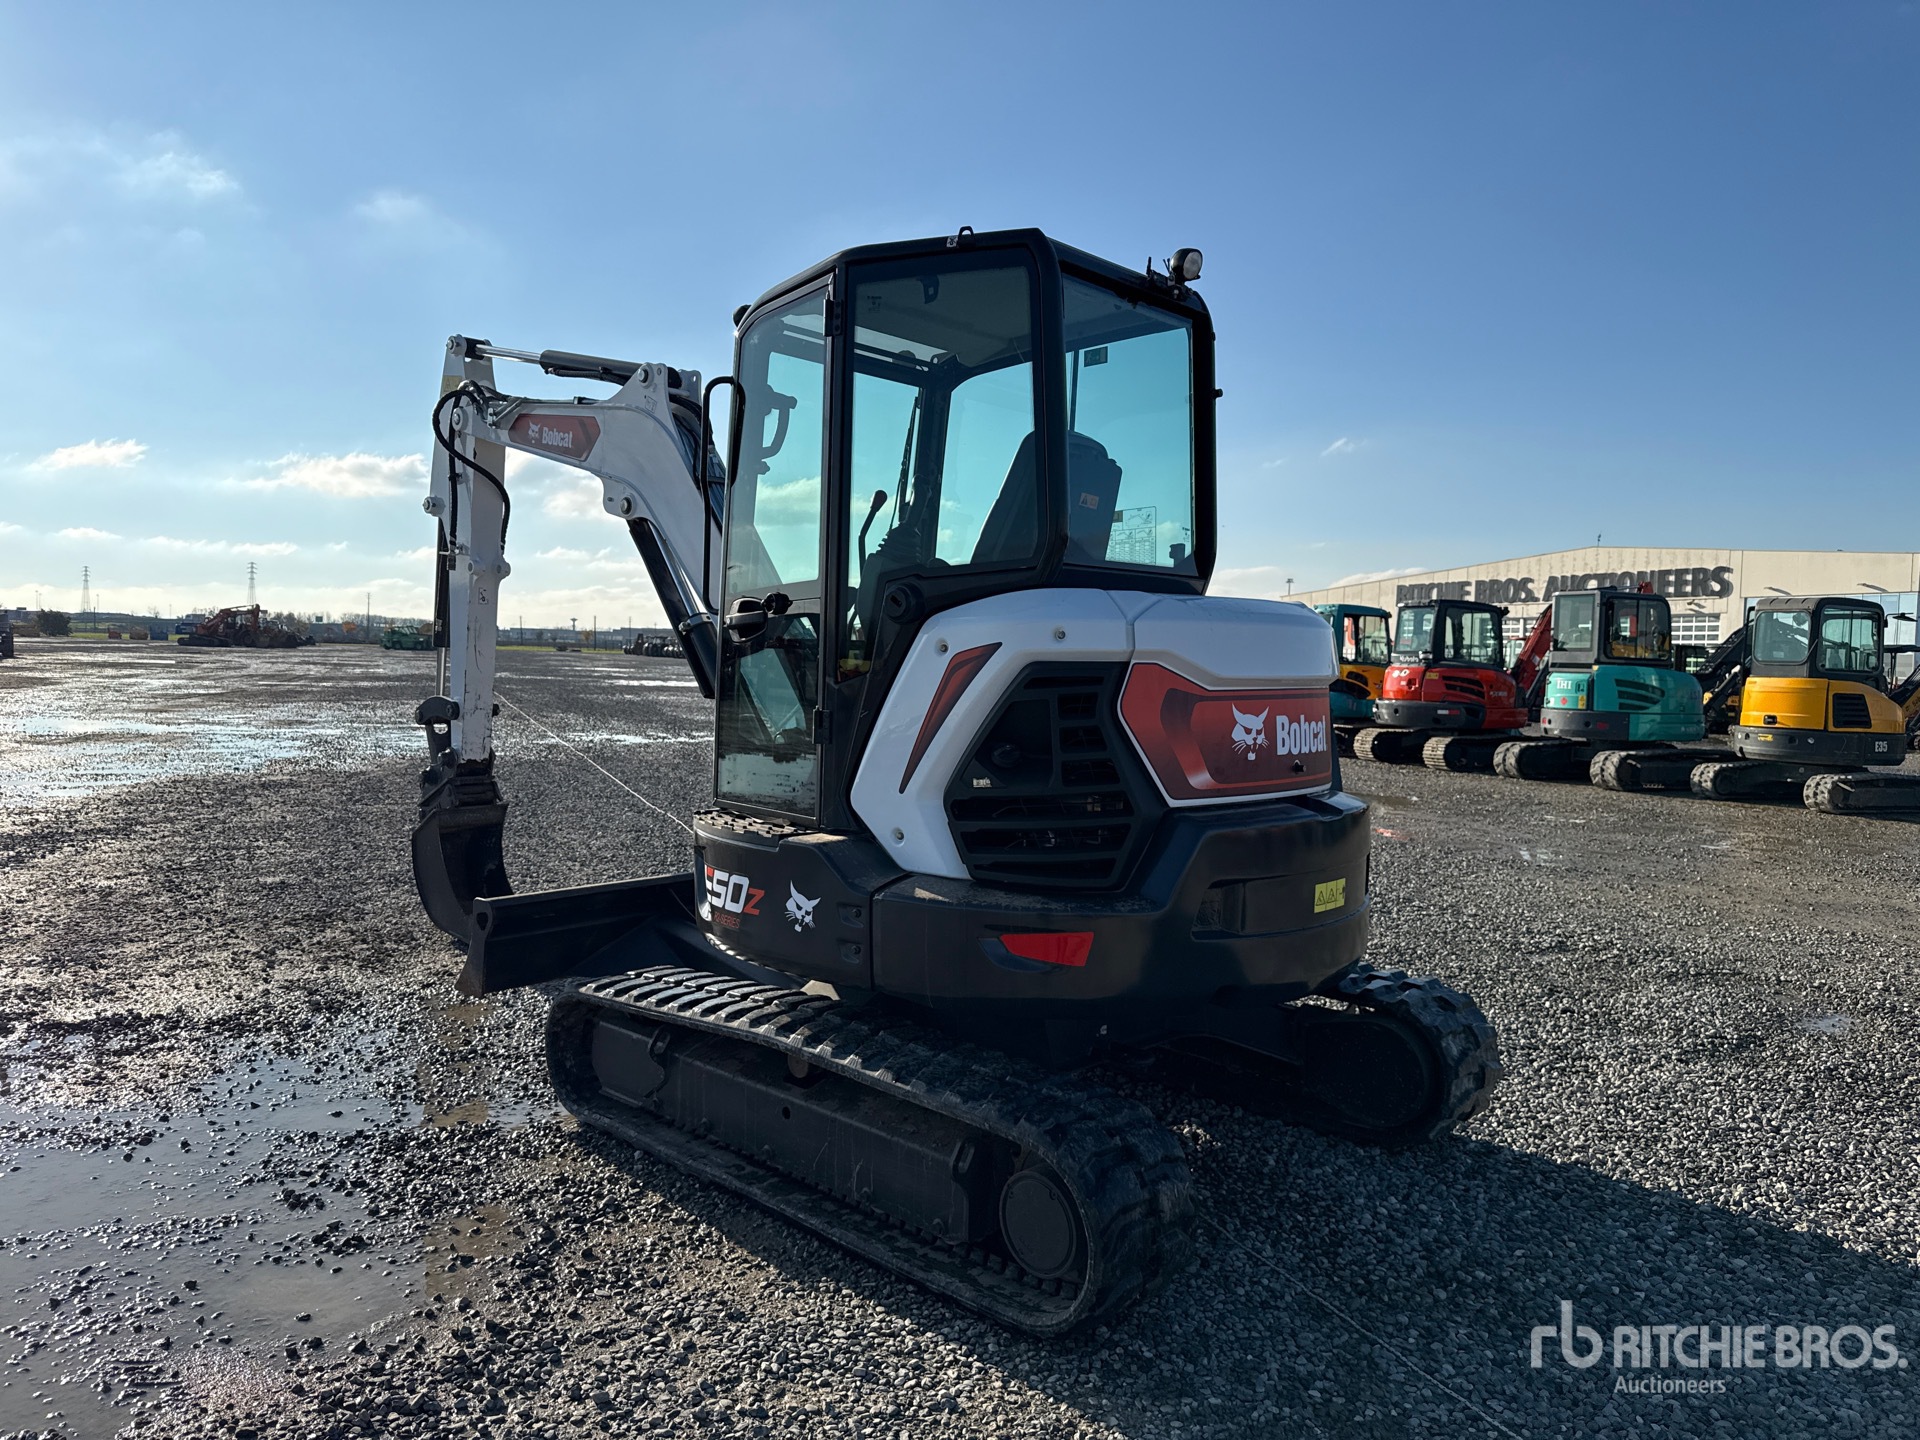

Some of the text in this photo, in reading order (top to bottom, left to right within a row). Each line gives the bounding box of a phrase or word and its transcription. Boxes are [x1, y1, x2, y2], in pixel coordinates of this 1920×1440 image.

[542, 427, 573, 448] Bobcat
[1396, 581, 1472, 604] RITCHIE
[1474, 577, 1540, 603] BROS.
[1556, 679, 1572, 690] IHI
[1276, 714, 1327, 756] Bobcat
[1874, 741, 1888, 753] E35
